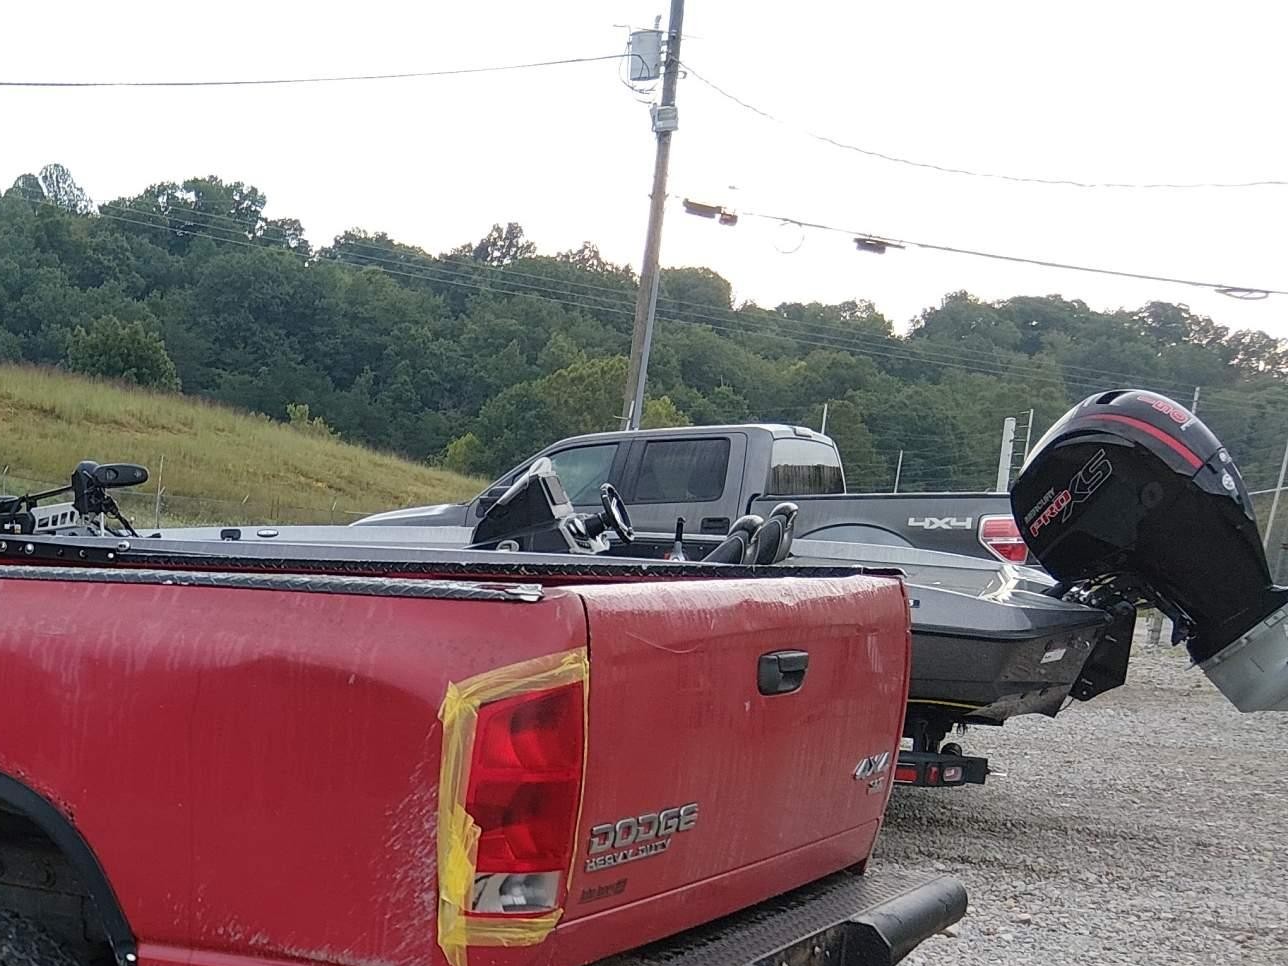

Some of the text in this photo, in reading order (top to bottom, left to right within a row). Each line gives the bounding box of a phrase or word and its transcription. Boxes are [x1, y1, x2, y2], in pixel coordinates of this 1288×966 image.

[1029, 448, 1113, 537] PRO XS
[589, 802, 699, 855] DODGE
[585, 838, 672, 873] HEAVY DUTY
